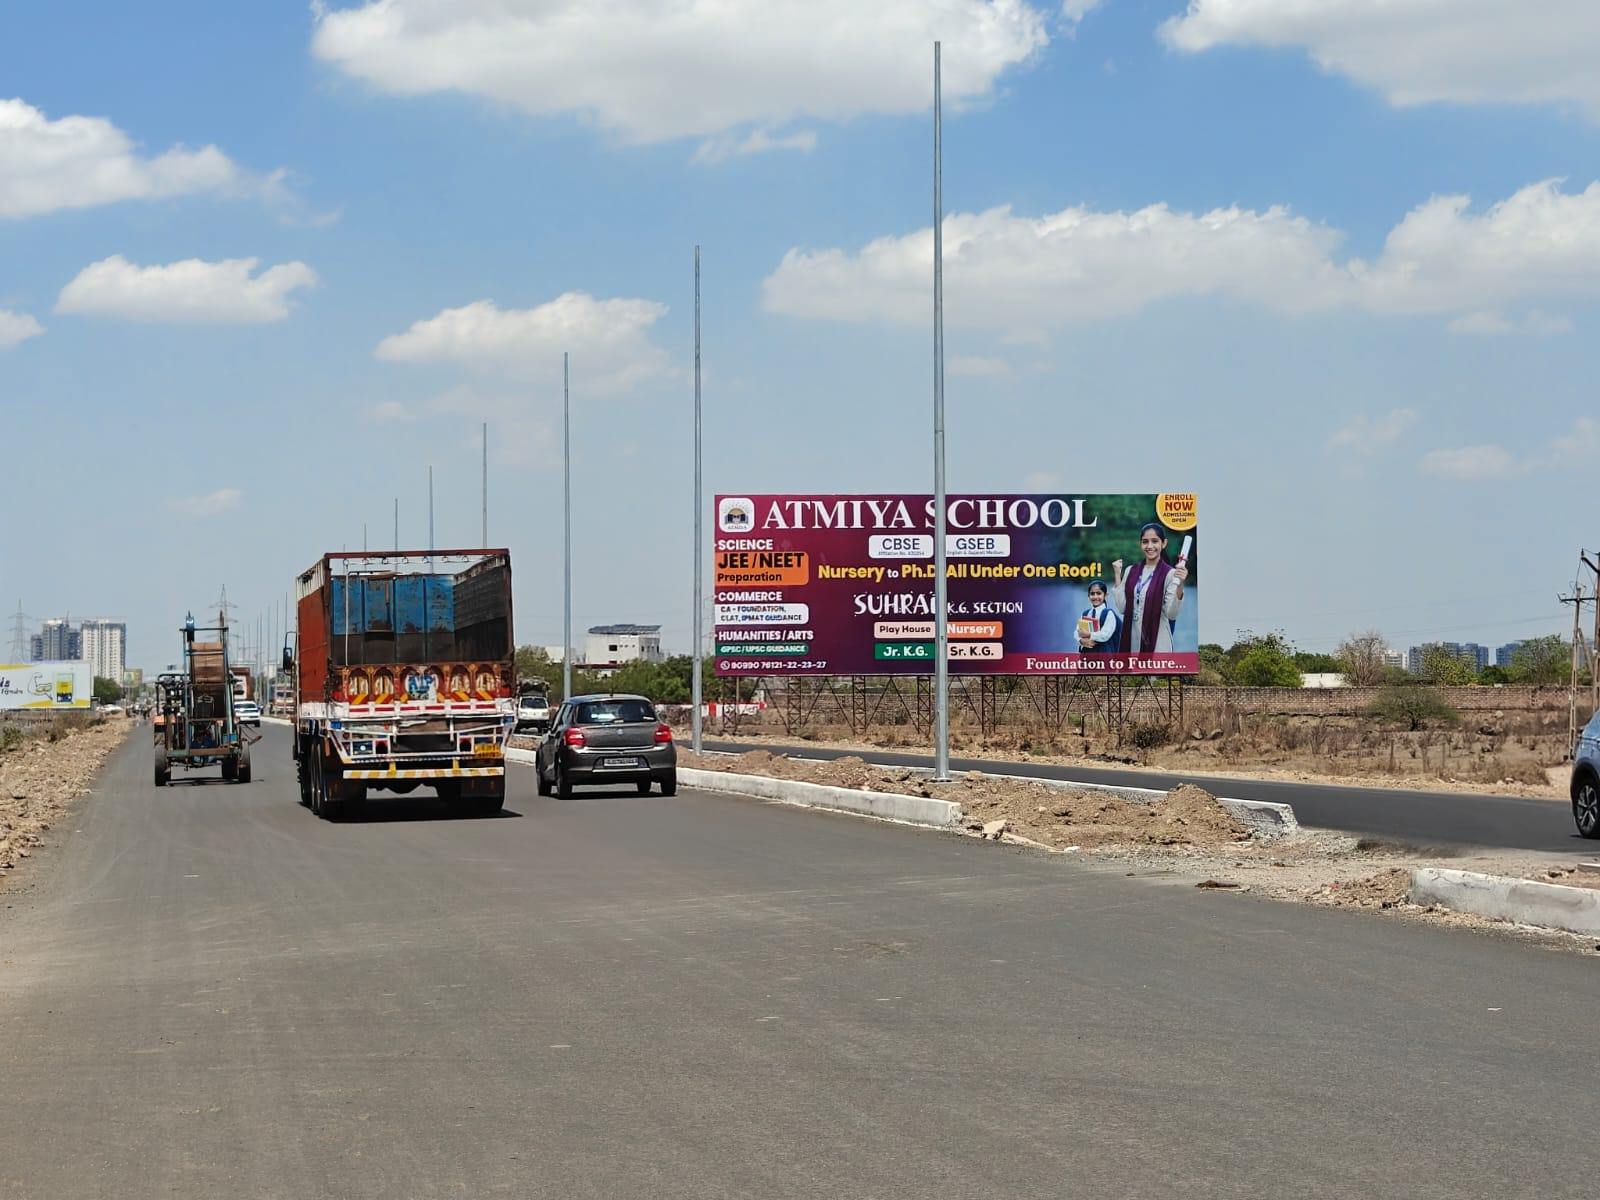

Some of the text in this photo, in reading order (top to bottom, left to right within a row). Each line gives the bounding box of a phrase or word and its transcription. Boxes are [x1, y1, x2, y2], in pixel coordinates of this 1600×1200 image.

[1165, 502, 1193, 511] NOW
[762, 500, 916, 529] ATMIYA
[718, 539, 773, 550] SCIENCE
[882, 538, 920, 550] CBSE
[956, 538, 995, 550] GSEB
[718, 553, 749, 568] JEE
[760, 553, 804, 568] NEET
[818, 565, 885, 582] Nursery
[888, 568, 899, 578] to
[946, 563, 967, 578] All
[970, 563, 1021, 578] Under
[1023, 564, 1056, 578] One
[1059, 562, 1102, 578] Roof!
[718, 572, 782, 584] Preparation
[718, 592, 782, 601] COMMERCE
[738, 605, 786, 613] FOUNDATION,
[947, 602, 969, 614] K.G.
[973, 601, 1023, 614] SECTION
[880, 625, 931, 634] Play House
[947, 624, 996, 635] Nursery
[719, 631, 781, 641] HUMANITIES
[787, 630, 814, 640] ARTS
[883, 646, 928, 656] Jr. K.G.
[950, 646, 994, 656] Sr. K.G.
[1026, 657, 1187, 670] Foundation to Future...
